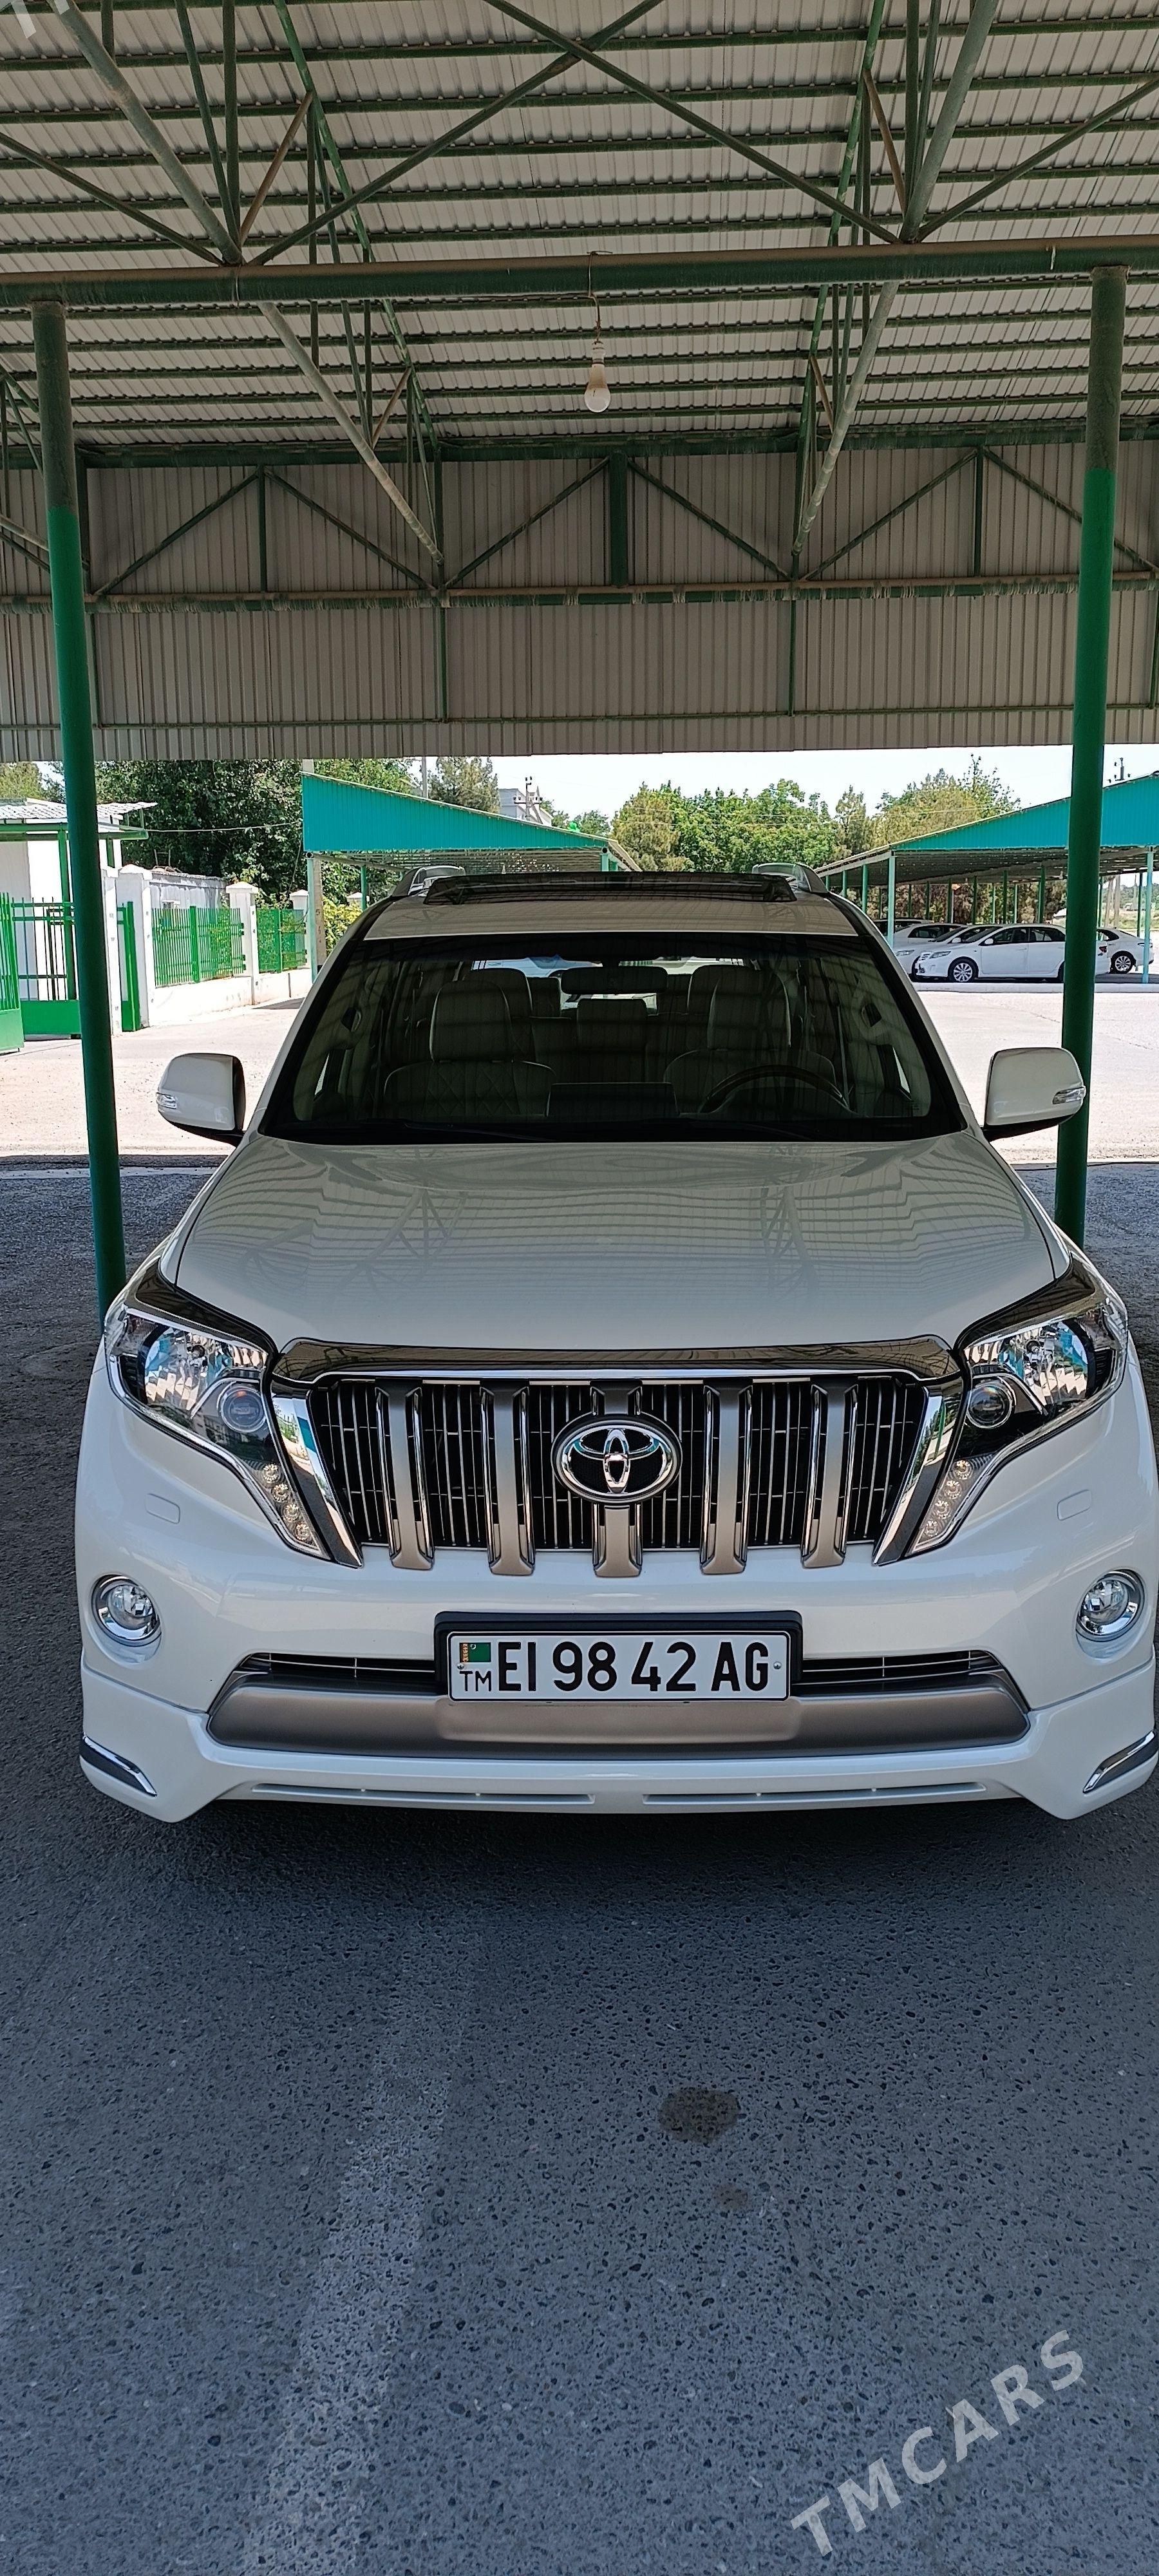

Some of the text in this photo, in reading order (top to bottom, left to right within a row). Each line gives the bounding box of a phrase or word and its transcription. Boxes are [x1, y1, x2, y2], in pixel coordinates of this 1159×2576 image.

[459, 1671, 491, 1692] TM
[498, 1641, 768, 1692] EI 98 42 AG
